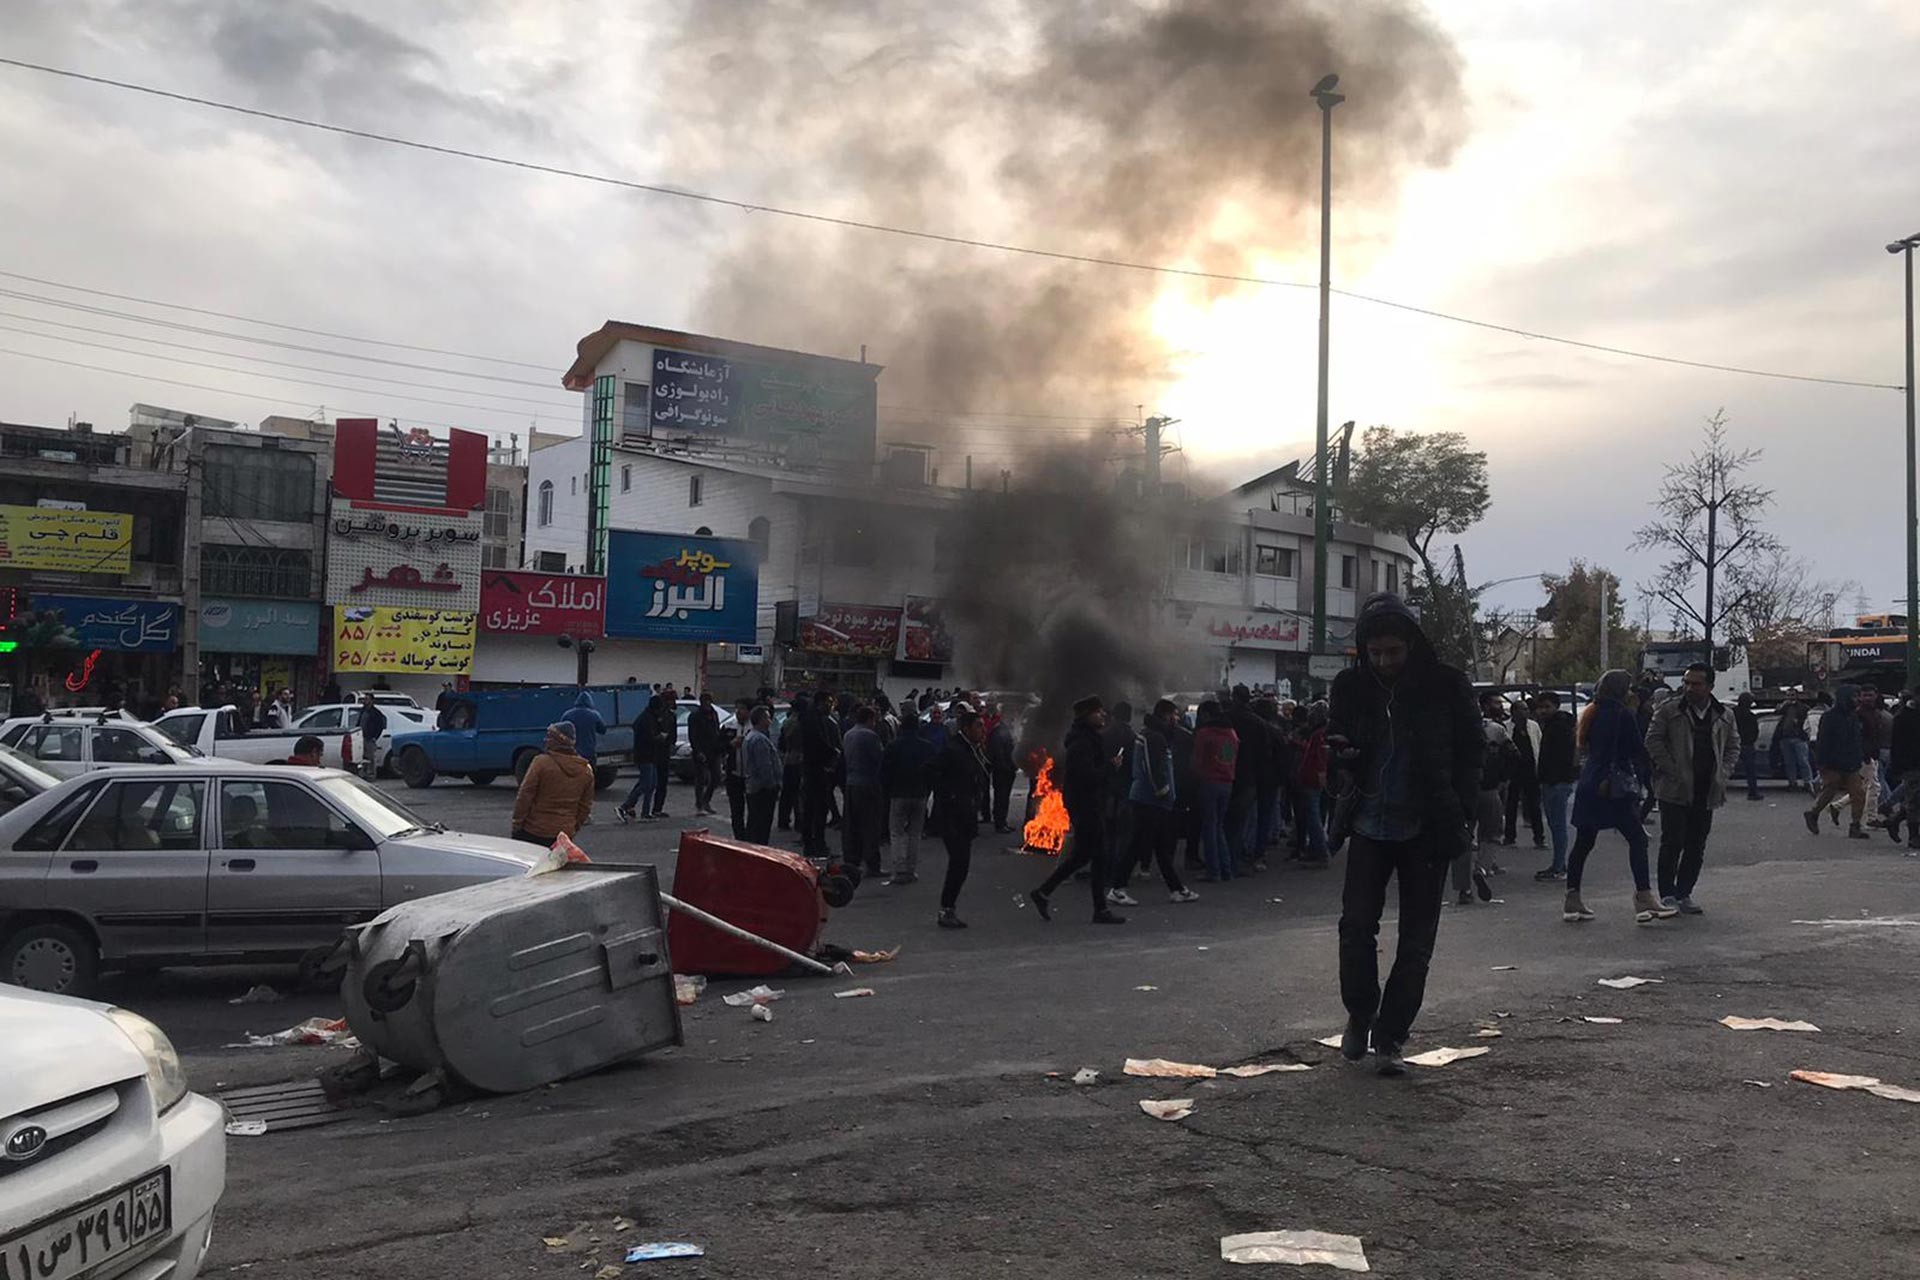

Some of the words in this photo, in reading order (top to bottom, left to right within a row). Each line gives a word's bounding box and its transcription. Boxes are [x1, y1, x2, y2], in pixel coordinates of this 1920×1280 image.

[656, 357, 731, 383] آزمایشگاه
[655, 381, 729, 405] رادیولوژی
[654, 403, 728, 427] سونوگرافی
[29, 528, 69, 541] چی
[75, 528, 118, 544] قلم
[335, 511, 420, 550] پروتئین
[425, 526, 480, 552] سوپر
[675, 549, 731, 573] سوپر
[350, 562, 462, 593] شهر
[527, 580, 602, 610] املاک
[644, 575, 725, 619] البرز
[79, 603, 138, 627] گندم
[119, 607, 173, 648] گل
[486, 607, 540, 630] عزیزی
